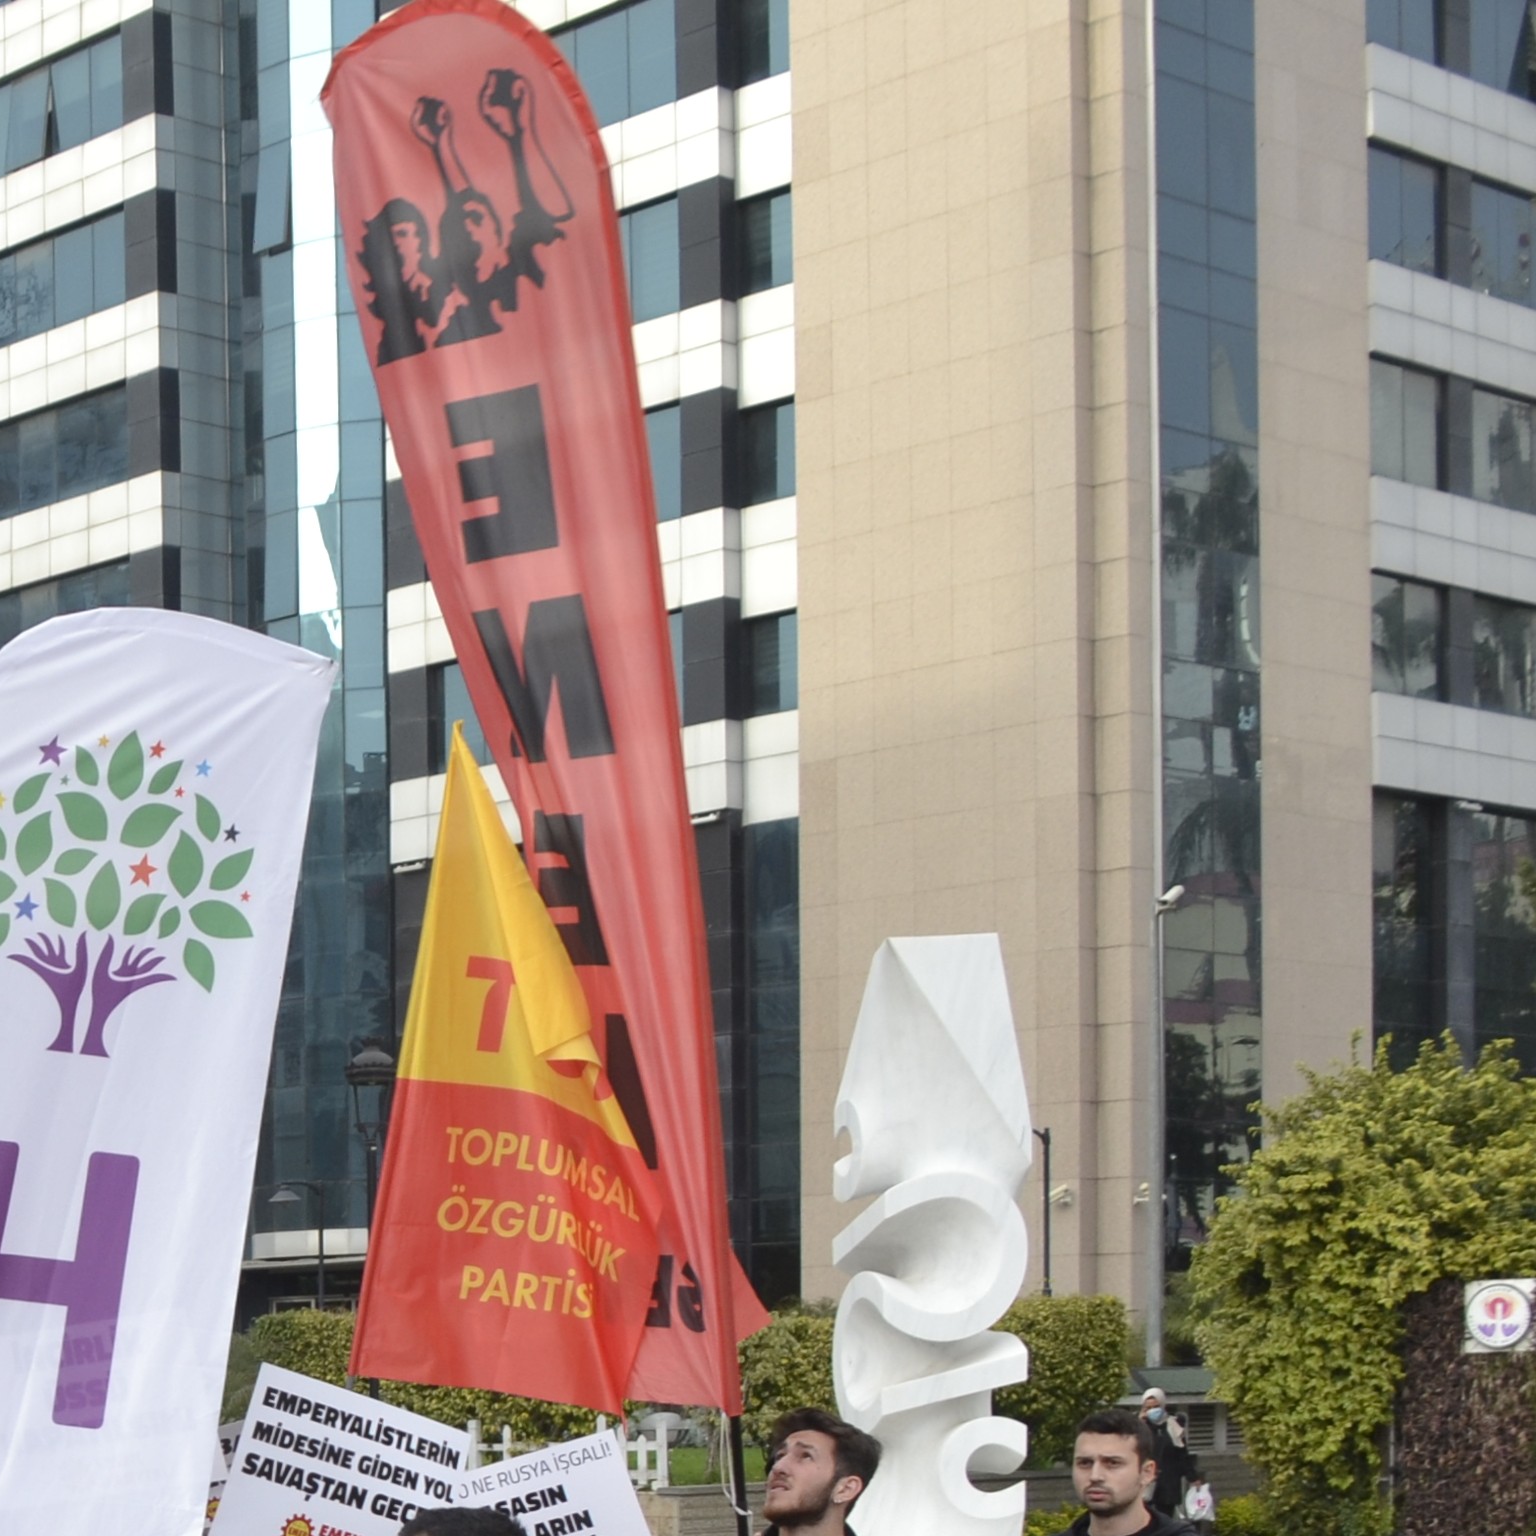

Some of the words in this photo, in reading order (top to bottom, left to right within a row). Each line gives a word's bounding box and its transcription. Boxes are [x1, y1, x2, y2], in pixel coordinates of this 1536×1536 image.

[446, 1127, 640, 1222] TOPLUMSAL
[437, 1185, 626, 1283] ÖZGÜRLÜK
[459, 1265, 593, 1318] PARTİS
[252, 1420, 355, 1469] MİDESİNE
[358, 1453, 419, 1491] GİDEN
[423, 1474, 455, 1504] YOL
[262, 1386, 460, 1470] EMPERYALİSTLERİN
[471, 1475, 495, 1496] NE
[496, 1459, 552, 1488] RUSYA
[553, 1439, 613, 1475] İŞGALİ!
[241, 1452, 368, 1510] SAVAŞTAN
